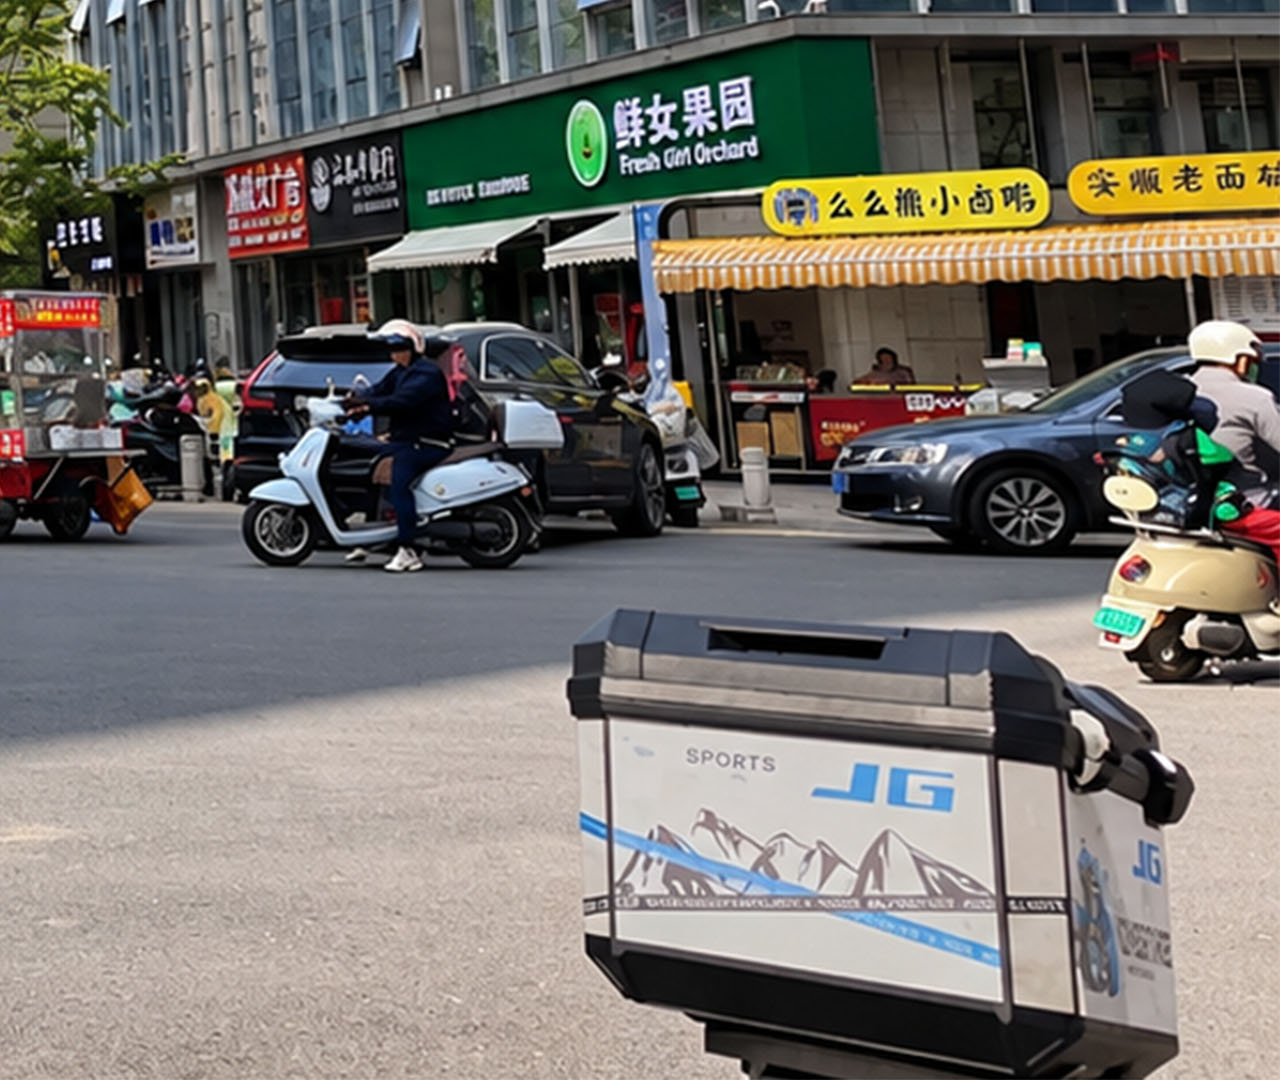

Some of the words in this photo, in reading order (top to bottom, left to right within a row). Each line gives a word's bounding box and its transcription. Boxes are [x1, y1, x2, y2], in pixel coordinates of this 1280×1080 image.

[613, 75, 756, 150] 鲜女果园
[619, 151, 662, 175] Fresh
[693, 135, 759, 166] Orchard
[685, 747, 777, 773] SPORTS
[810, 762, 955, 813] JG
[1132, 838, 1162, 885] JG
